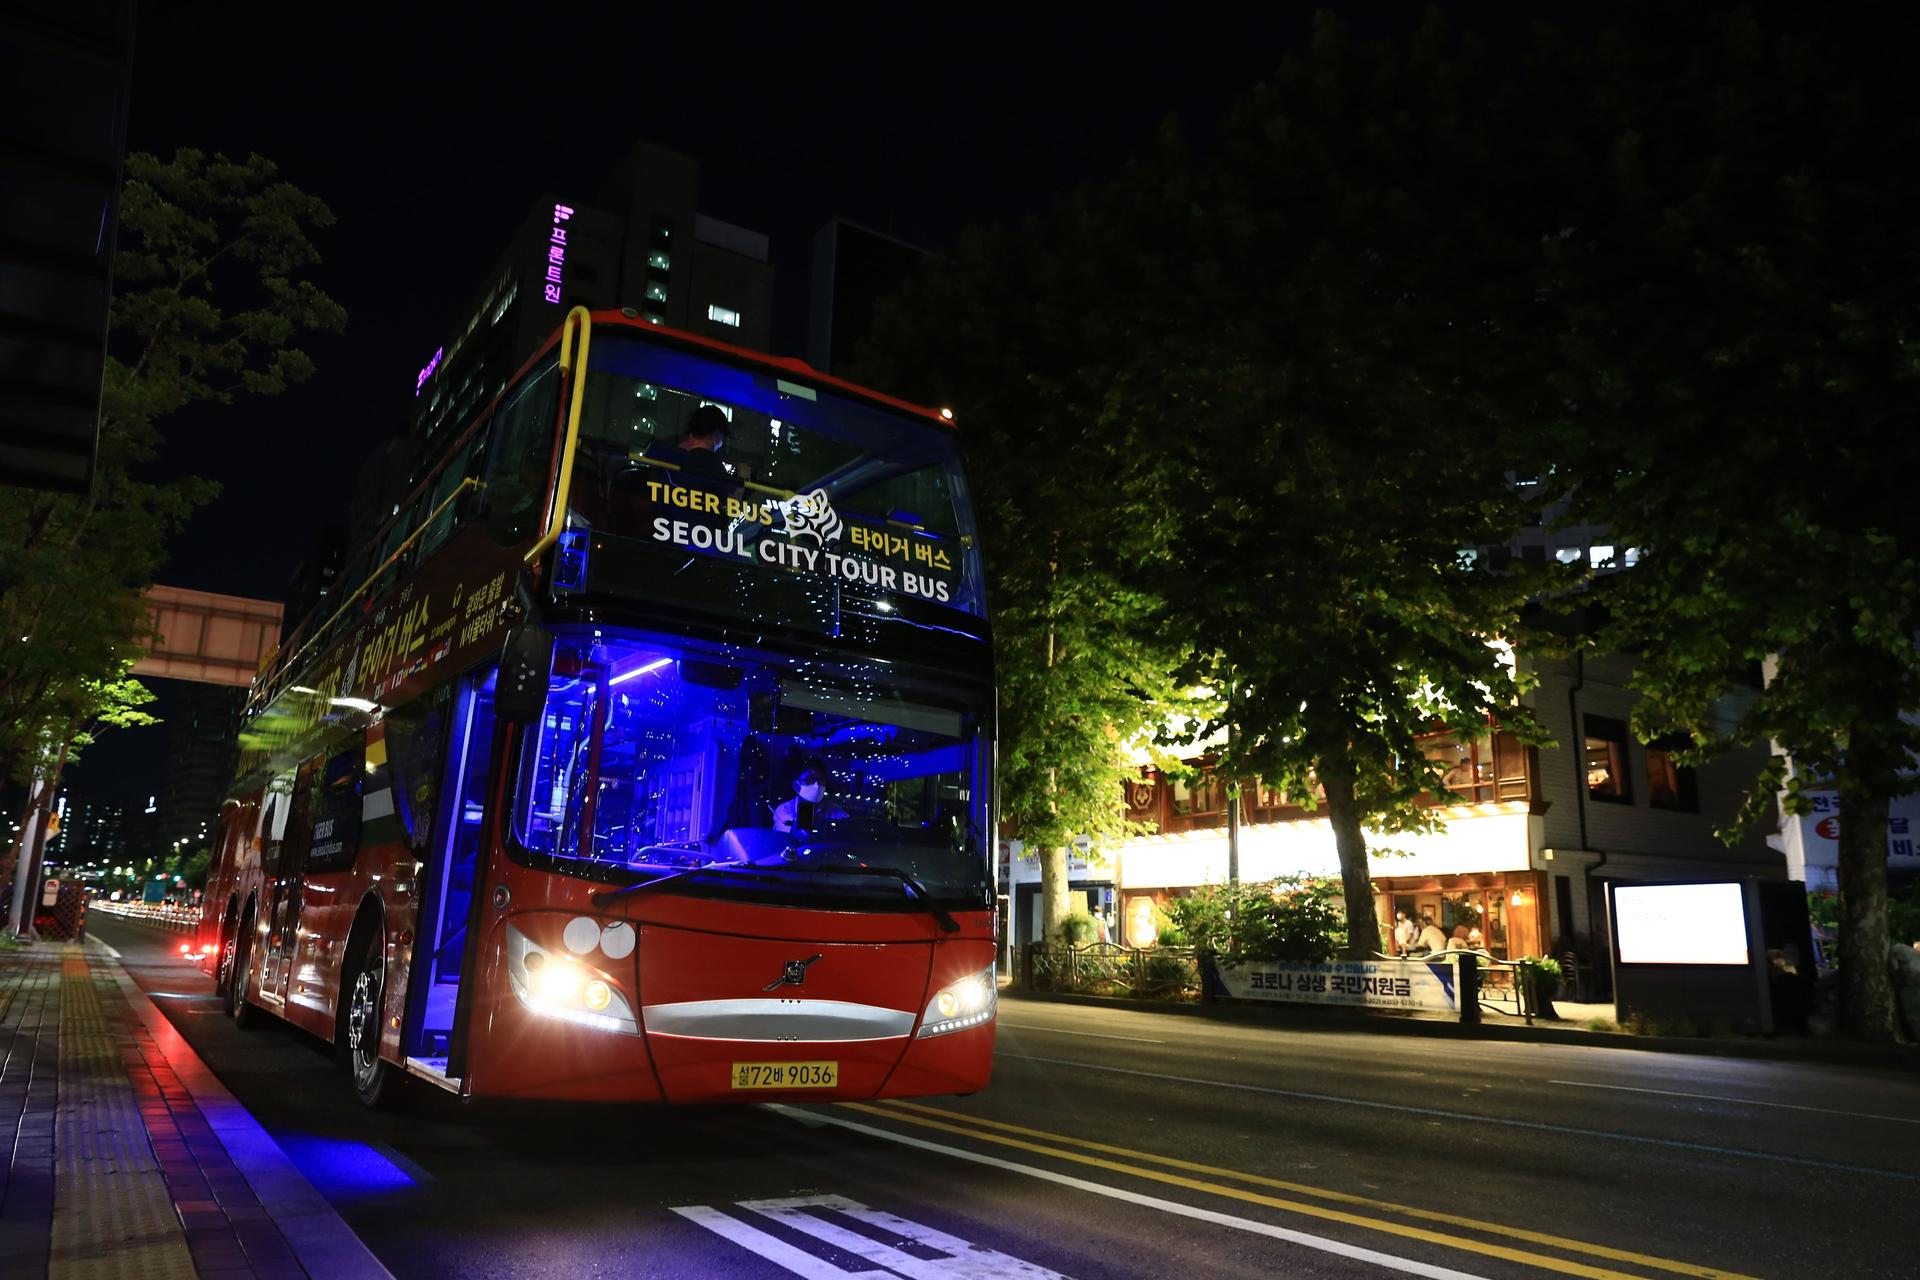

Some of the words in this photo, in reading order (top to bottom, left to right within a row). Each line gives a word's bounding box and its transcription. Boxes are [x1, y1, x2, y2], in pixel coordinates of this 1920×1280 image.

[544, 226, 567, 304] 프론트원
[646, 480, 719, 514] TIGER
[726, 498, 773, 526] BUS
[652, 517, 752, 557] SEOUL
[759, 538, 819, 571] CITY
[824, 552, 897, 590] TOUR
[903, 570, 950, 602] BUS
[851, 525, 909, 562] 타이거
[914, 544, 952, 571] 버스
[357, 614, 402, 692] 타이거
[397, 593, 430, 663] 버스
[1250, 972, 1293, 991] 코로나
[1297, 973, 1327, 993] 상생
[1331, 974, 1411, 997] 국민지원금
[751, 1065, 784, 1085] 72바
[788, 1065, 832, 1084] 9036
